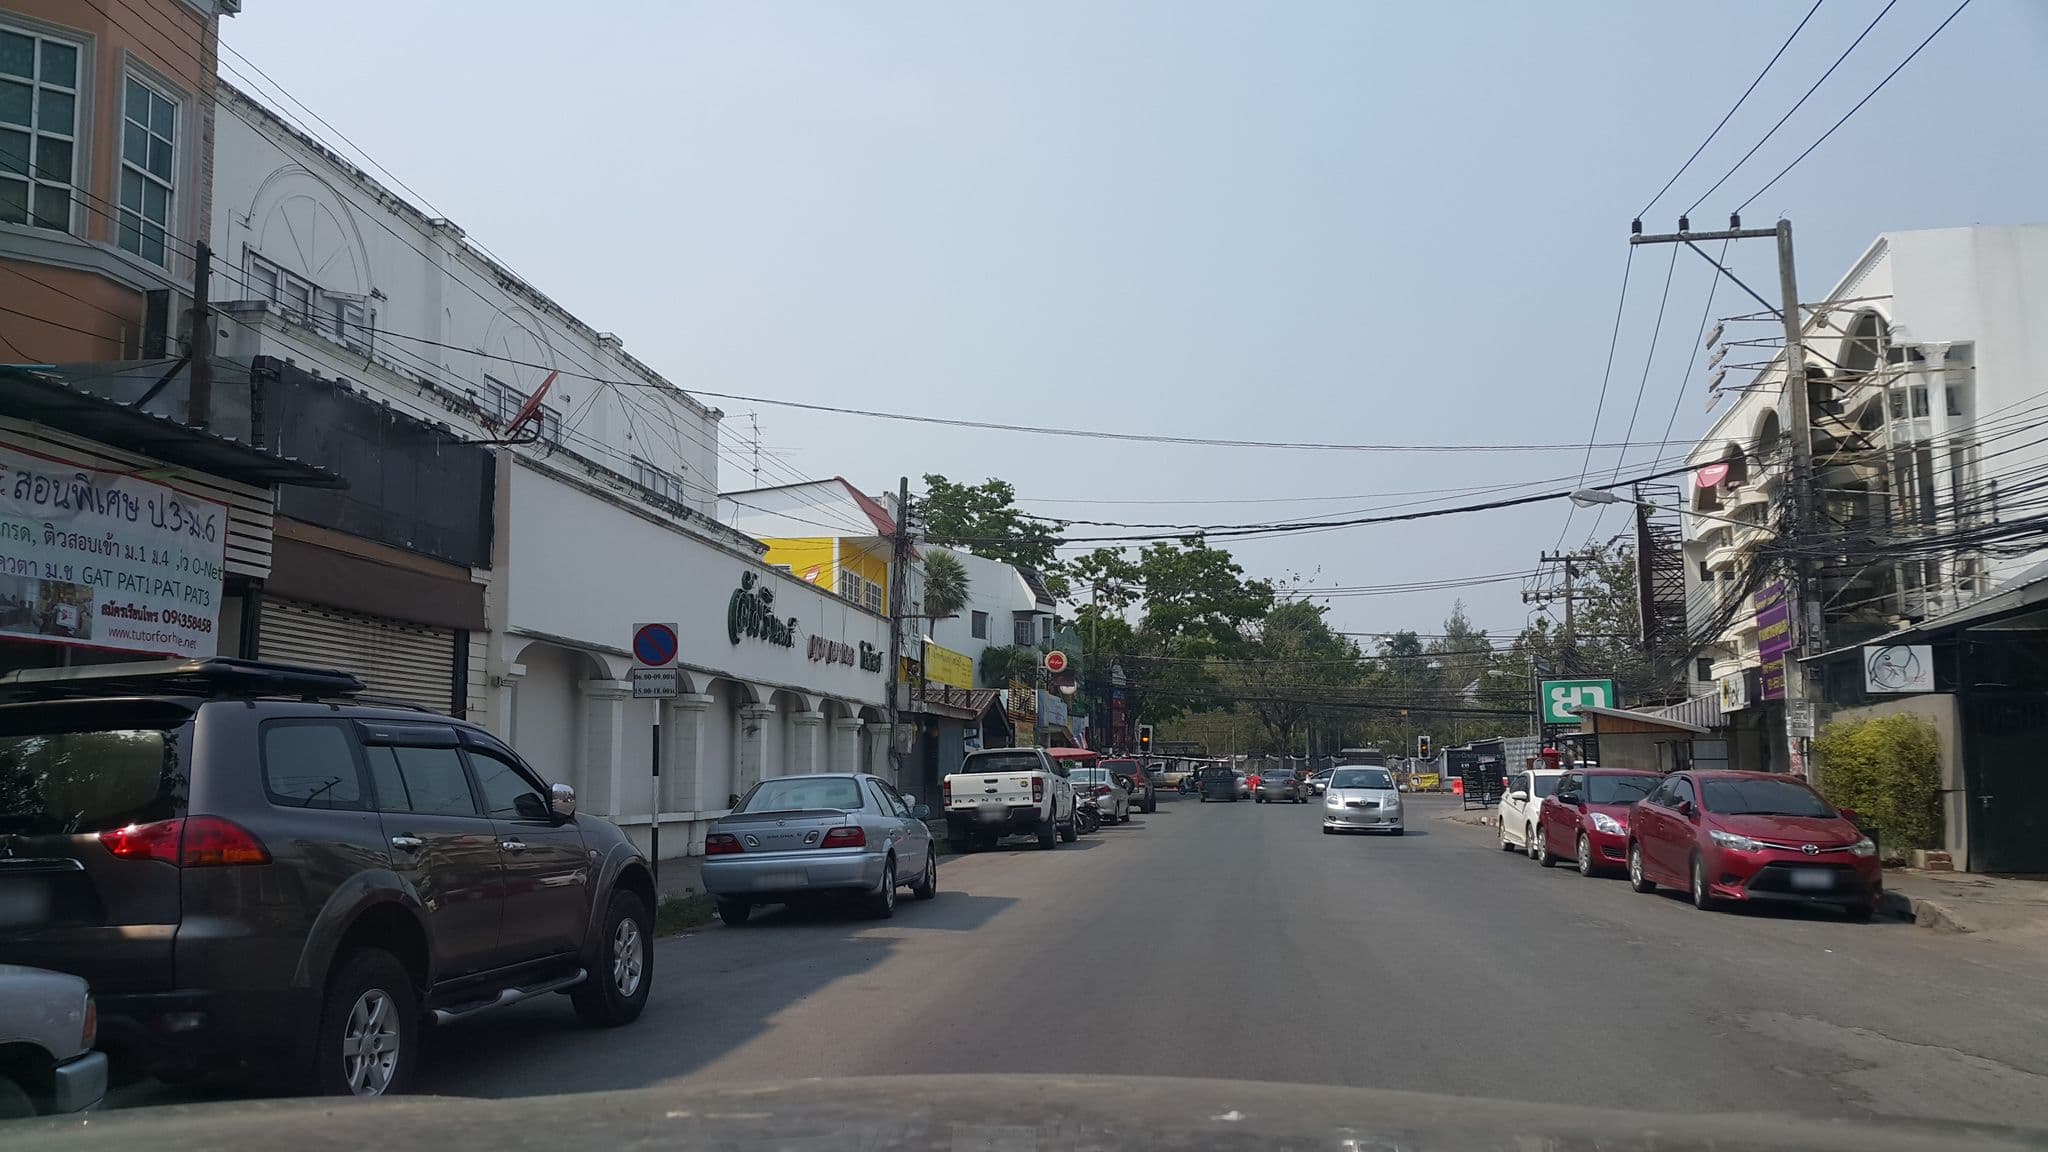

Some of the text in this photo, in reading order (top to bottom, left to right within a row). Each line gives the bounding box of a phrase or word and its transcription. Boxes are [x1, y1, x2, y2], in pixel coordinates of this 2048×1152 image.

[14, 470, 139, 522] สอนพิเศษ
[147, 492, 217, 543] ป.3-ม.6
[43, 522, 120, 558] ติวสอบเข้า
[124, 543, 146, 563] ม.1
[192, 559, 223, 582] O-Net
[82, 567, 111, 587] GAT
[184, 586, 210, 607] PAT3
[1551, 686, 1605, 718] ยา
[955, 796, 1030, 804] RANGER
